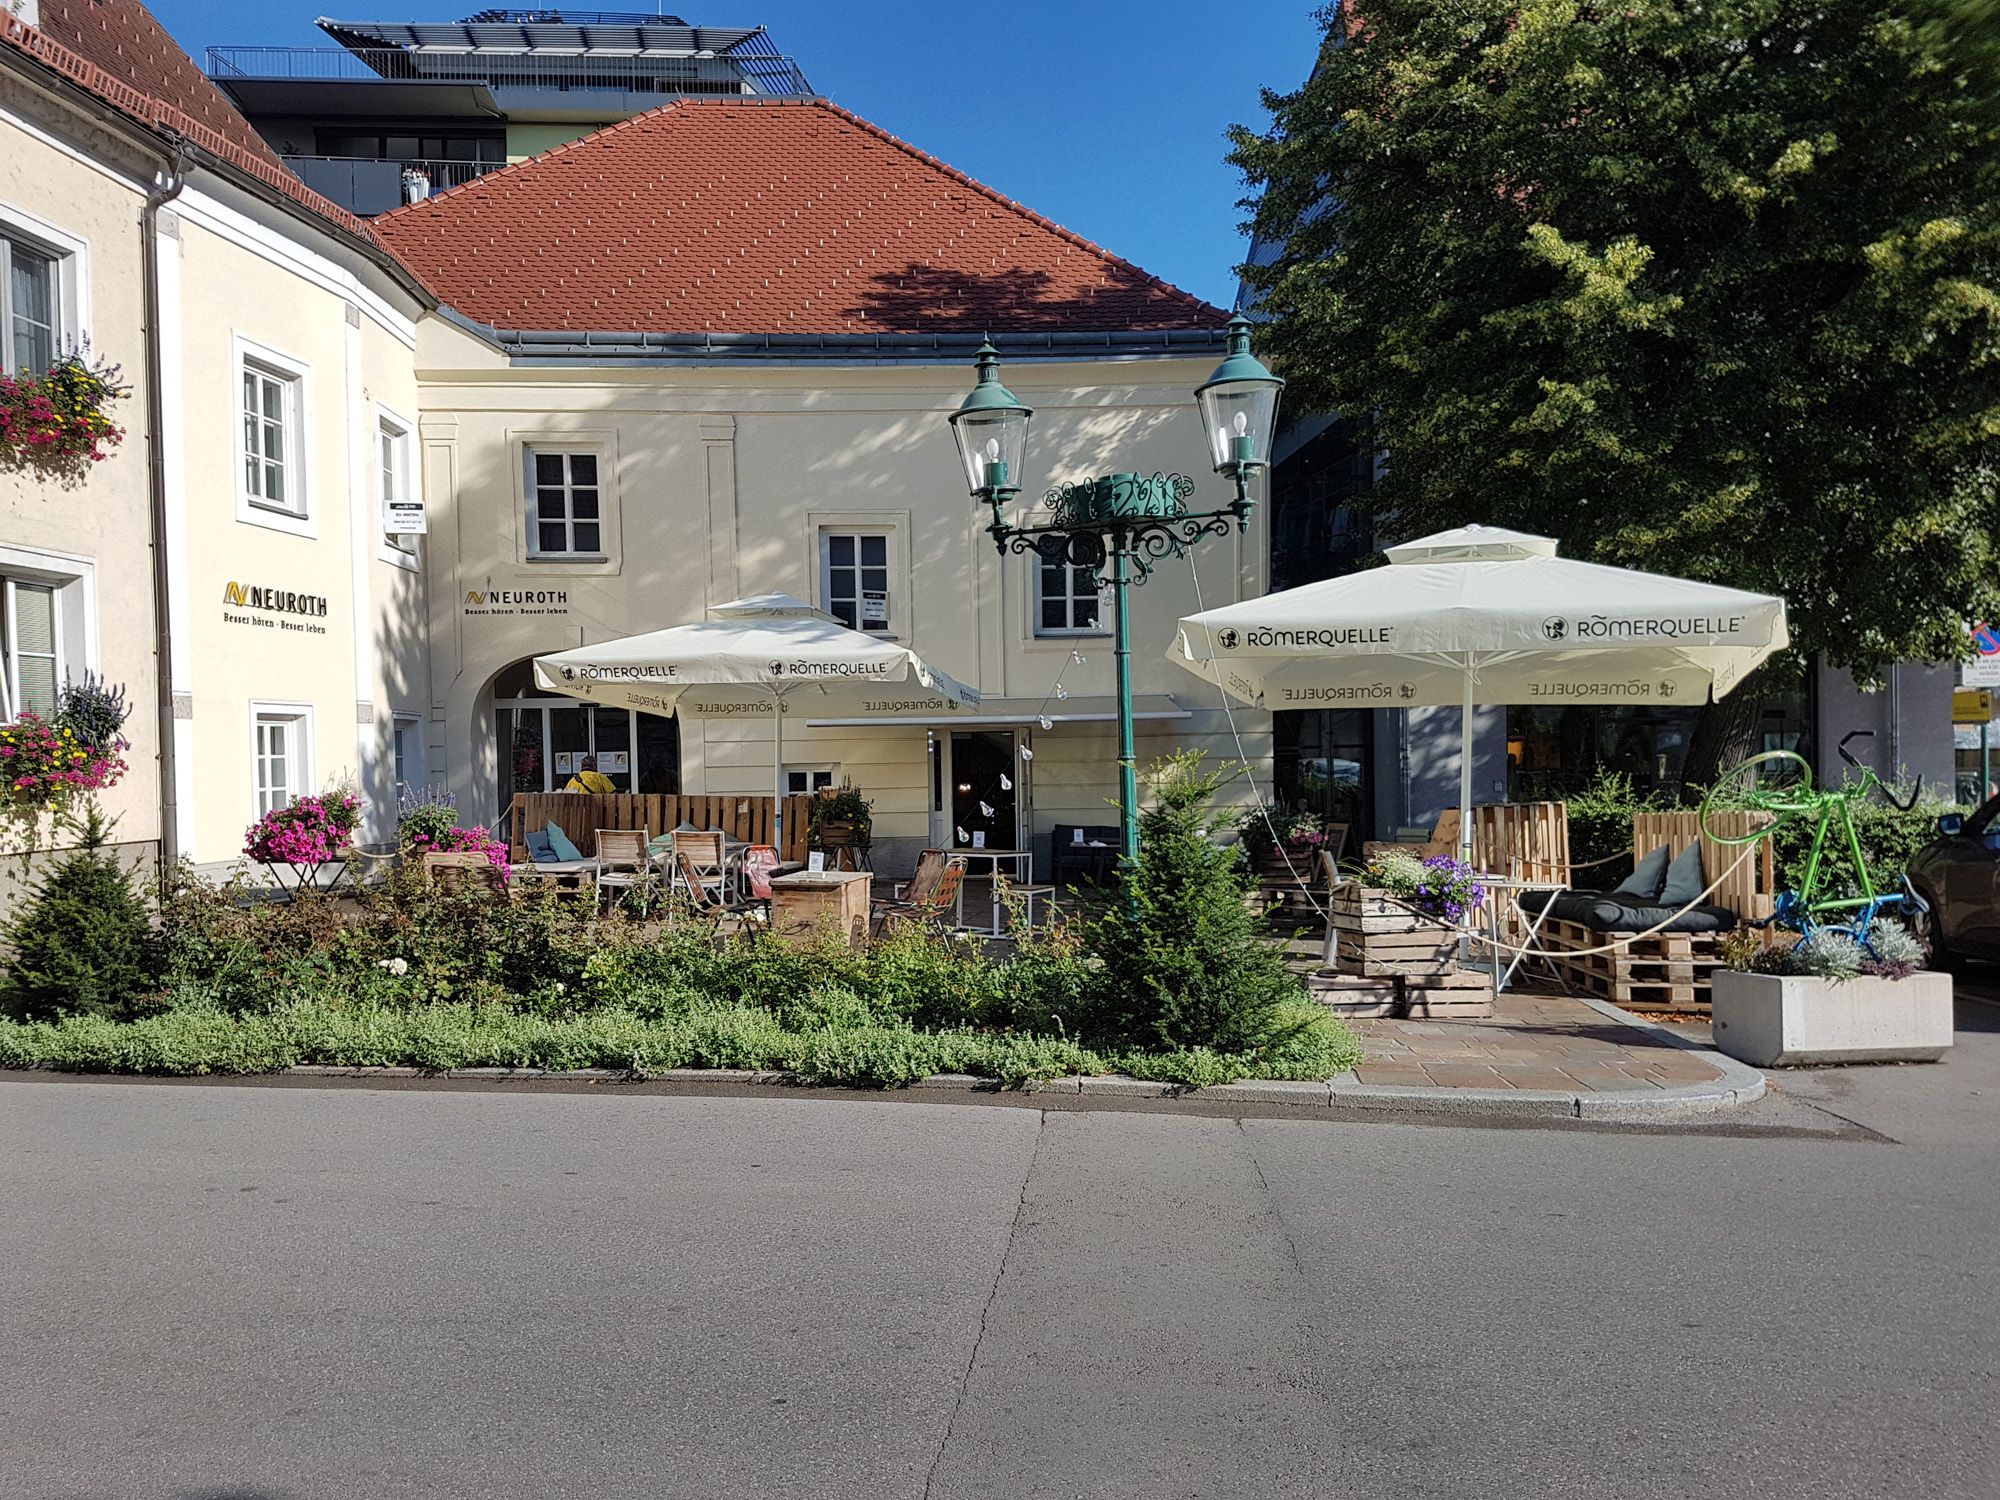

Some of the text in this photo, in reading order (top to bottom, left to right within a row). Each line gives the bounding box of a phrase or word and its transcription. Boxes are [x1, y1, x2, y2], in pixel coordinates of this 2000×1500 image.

[251, 586, 328, 617] NEUROTH
[490, 591, 568, 604] NEUROTH
[491, 607, 514, 615] hören
[546, 607, 568, 615] leben
[223, 612, 326, 635] Besser hören Besser leben
